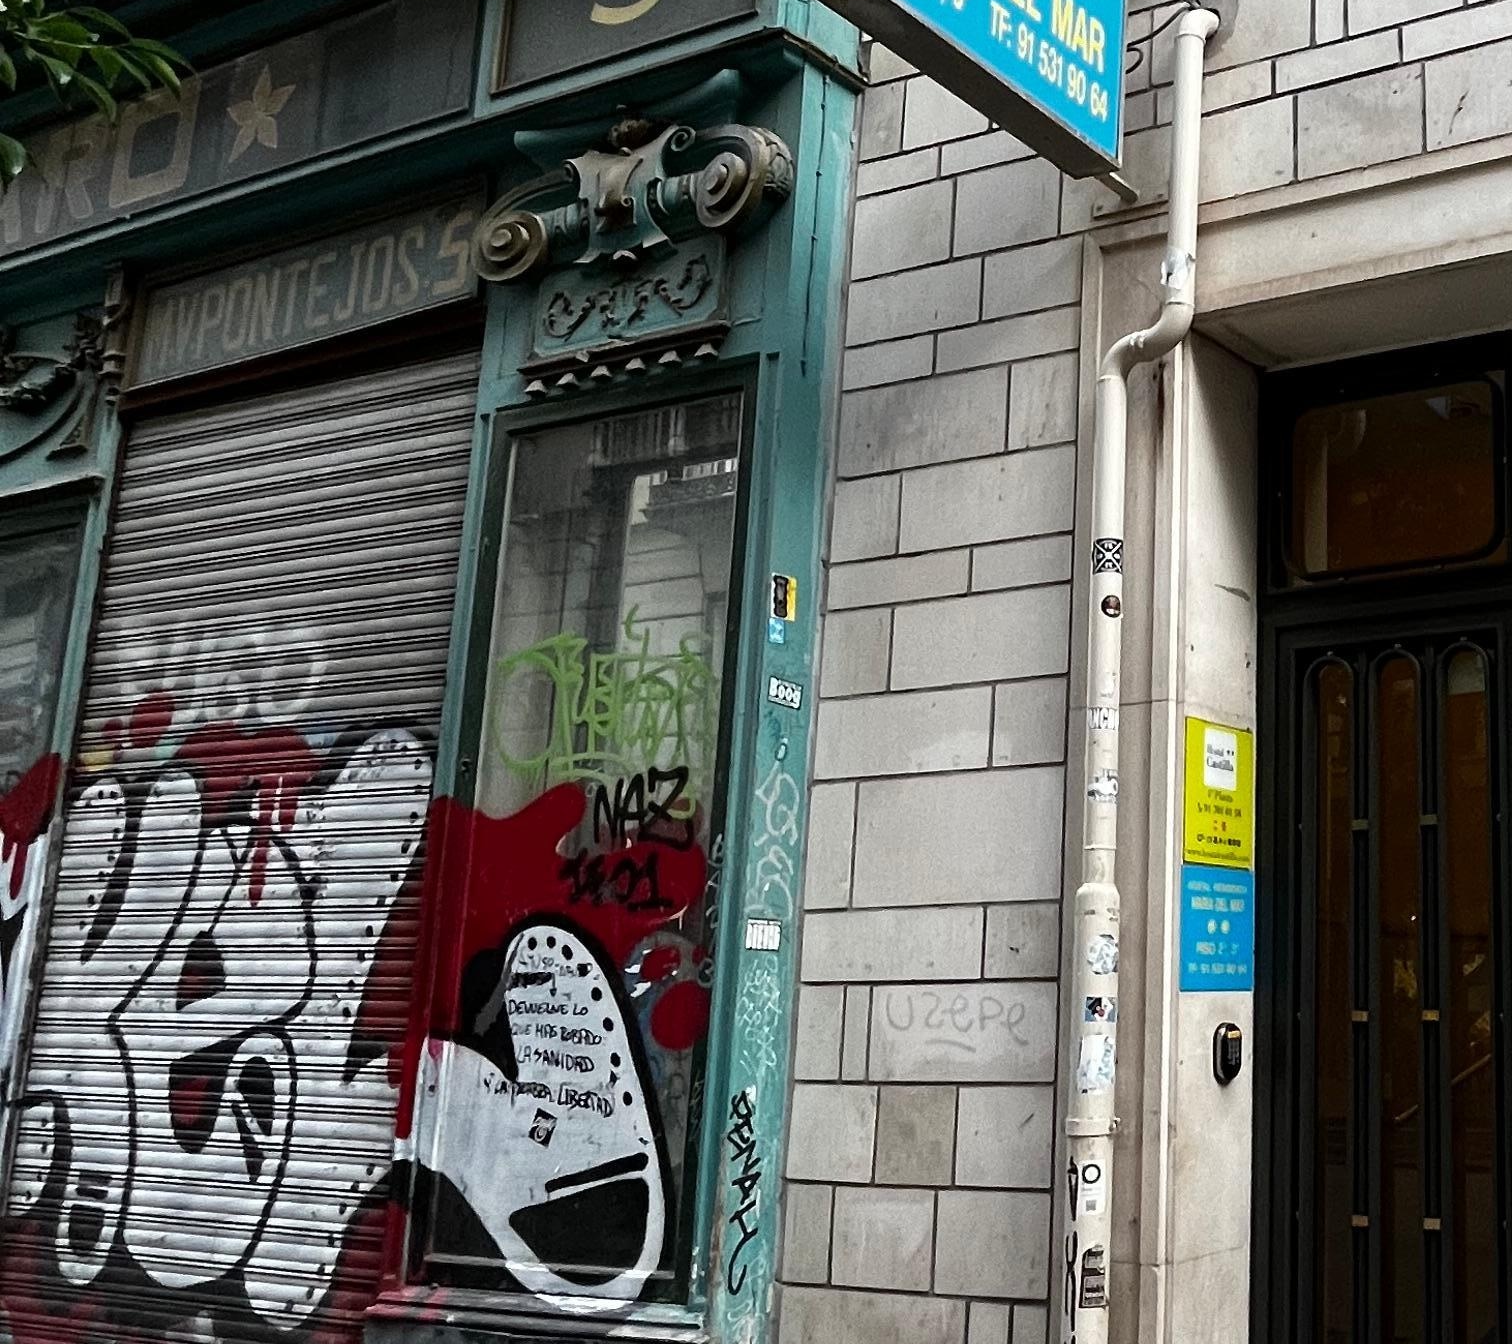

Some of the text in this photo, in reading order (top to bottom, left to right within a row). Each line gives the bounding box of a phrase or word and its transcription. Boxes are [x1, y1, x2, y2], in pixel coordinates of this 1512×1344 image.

[1017, 22, 1035, 65] 91
[1038, 39, 1064, 87] 531
[1066, 63, 1087, 105] 90
[1090, 82, 1108, 123] 64
